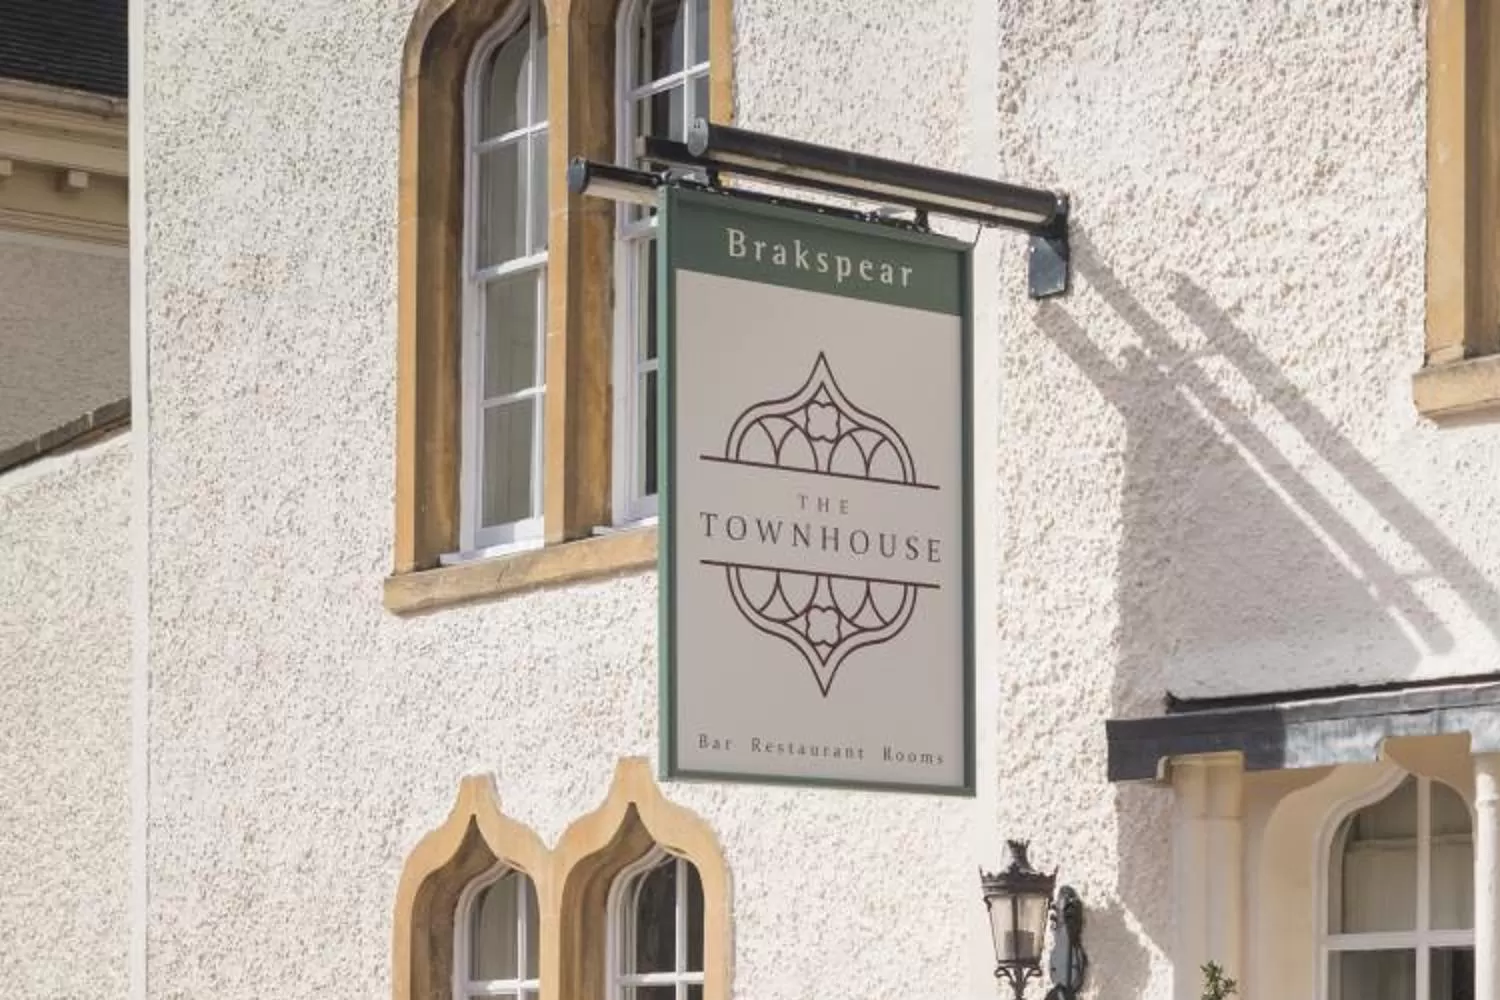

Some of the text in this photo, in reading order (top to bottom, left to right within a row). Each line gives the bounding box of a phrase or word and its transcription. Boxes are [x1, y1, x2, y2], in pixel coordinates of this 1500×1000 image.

[725, 227, 913, 288] Brakspear
[798, 493, 850, 516] THE
[699, 511, 942, 564] TOWNHOUSE
[698, 733, 945, 766] Bar Restaurant Rooms
